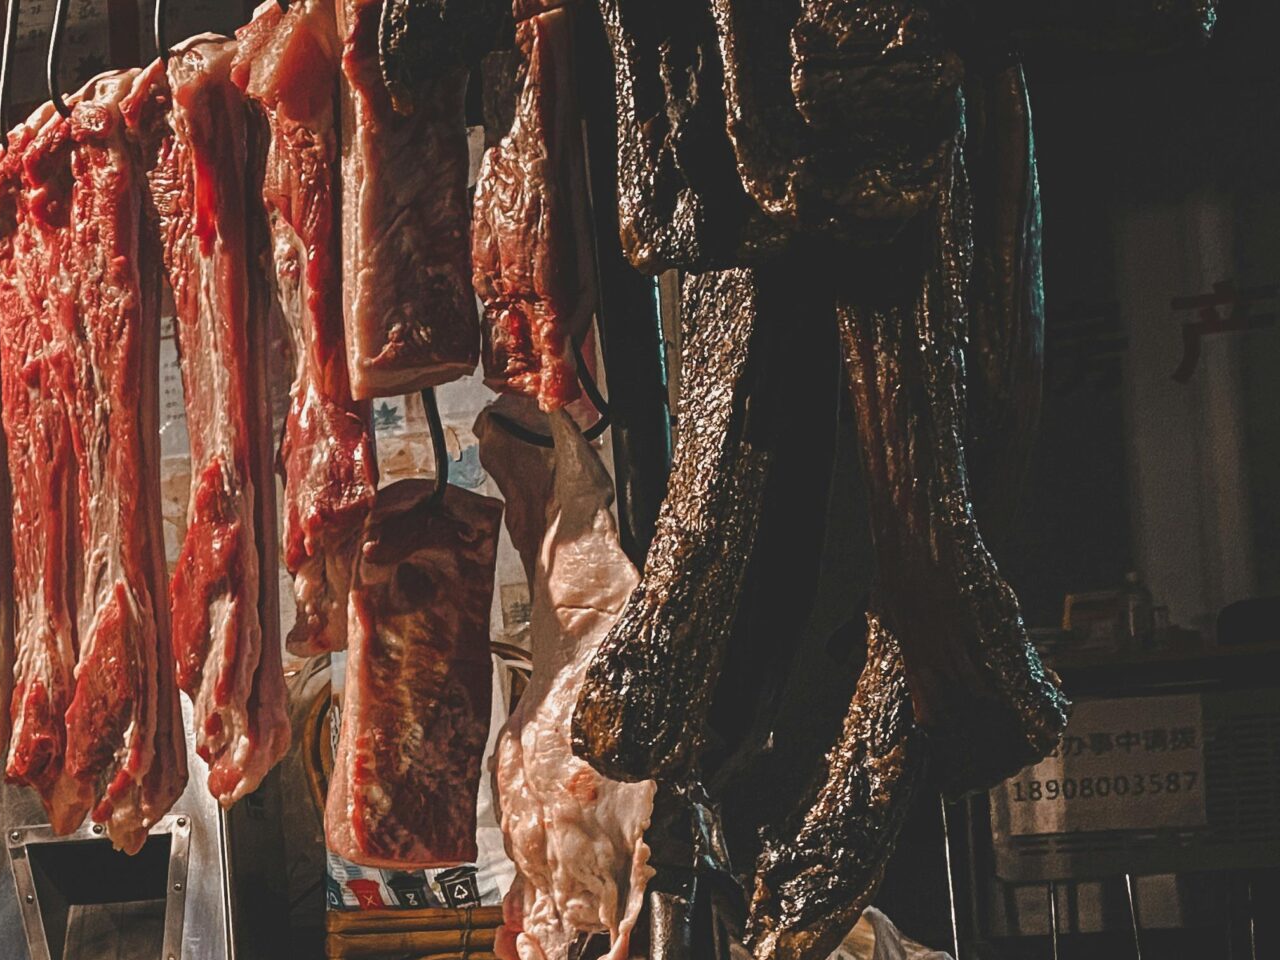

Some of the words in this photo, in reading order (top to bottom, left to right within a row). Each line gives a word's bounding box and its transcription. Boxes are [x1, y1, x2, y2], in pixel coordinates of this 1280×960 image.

[1049, 727, 1197, 759] 办事中请拨
[1012, 769, 1198, 802] 18908003587
